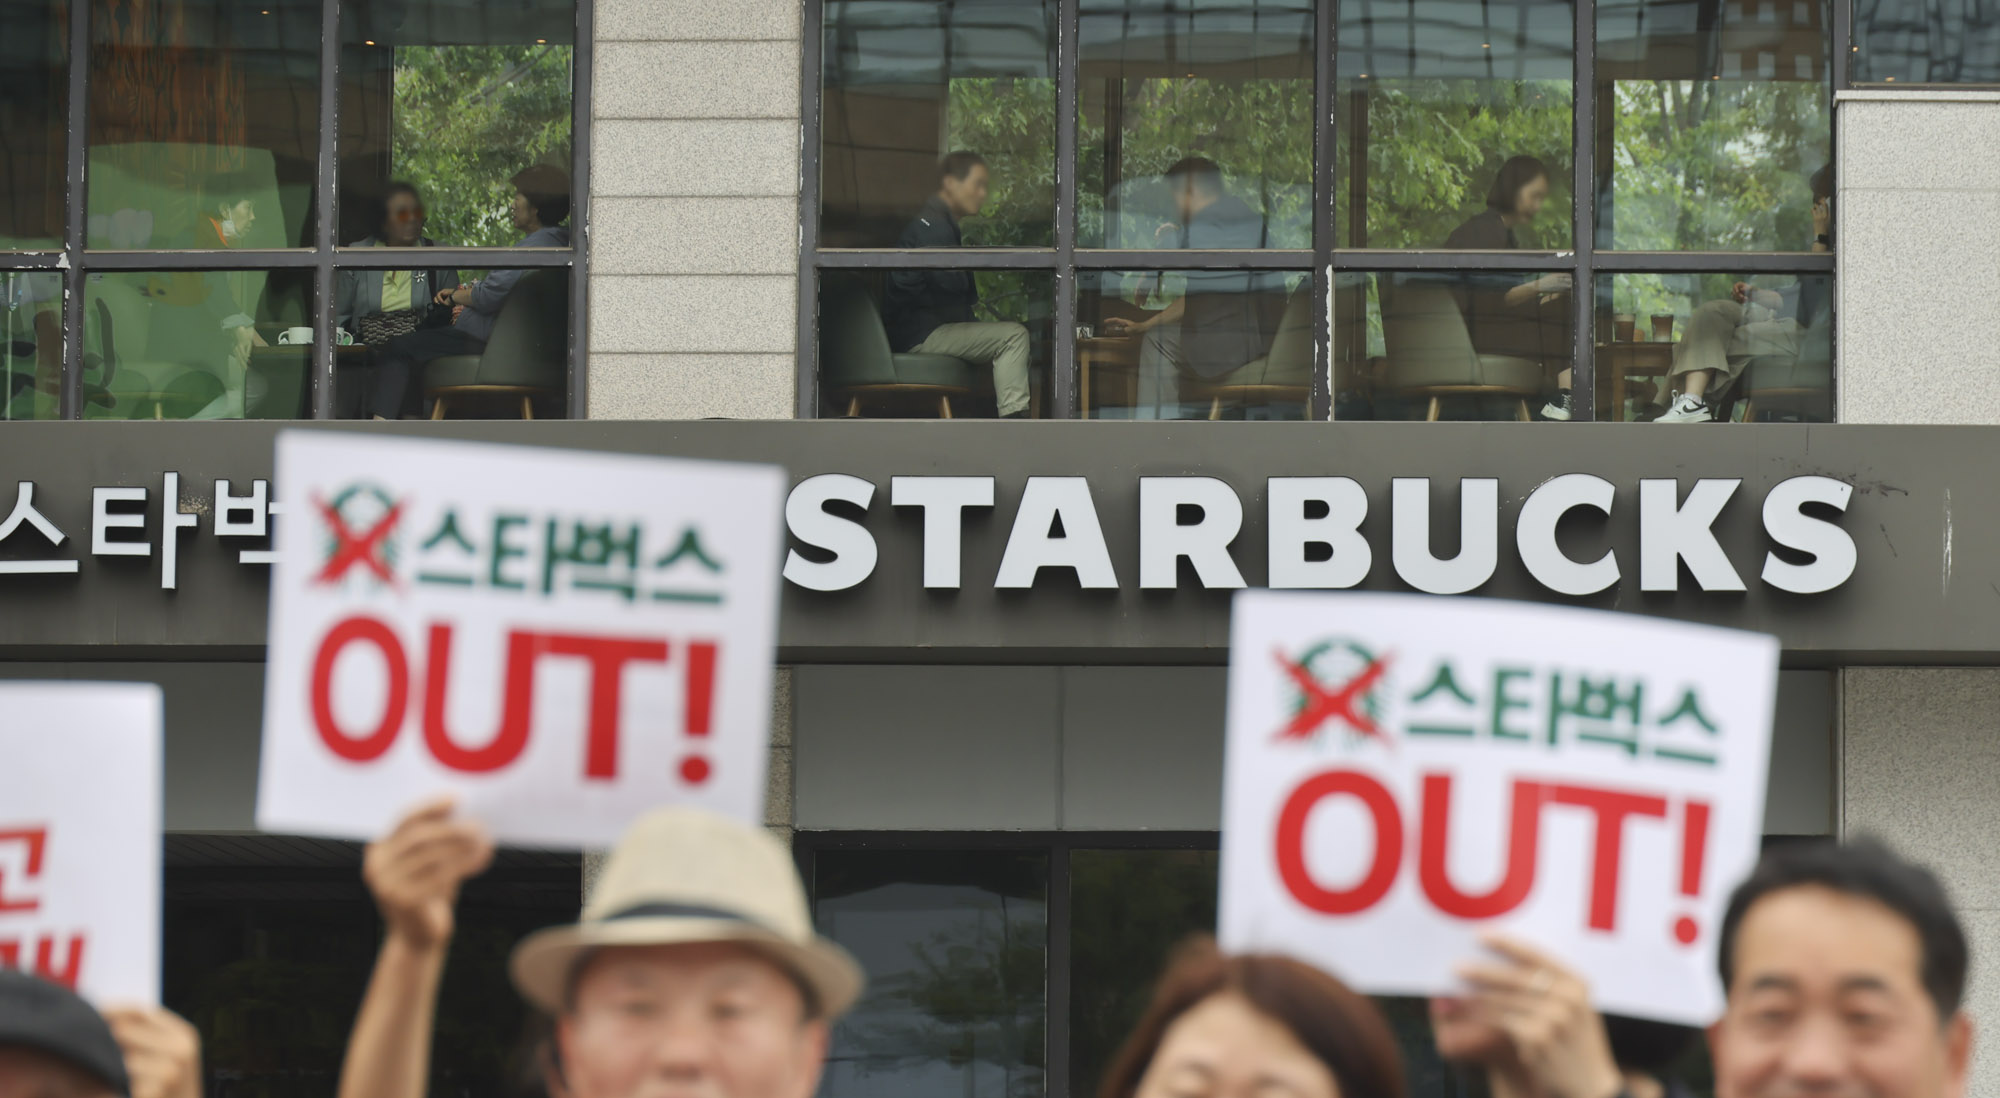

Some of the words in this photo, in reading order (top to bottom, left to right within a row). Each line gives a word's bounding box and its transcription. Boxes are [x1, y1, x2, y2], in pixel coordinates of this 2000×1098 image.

[414, 508, 726, 606] 스타벅스
[782, 472, 1857, 596] STARBUCKS
[309, 614, 720, 786] OUT!
[1405, 660, 1721, 767] 스타벅스
[1273, 768, 1712, 947] OUT!
